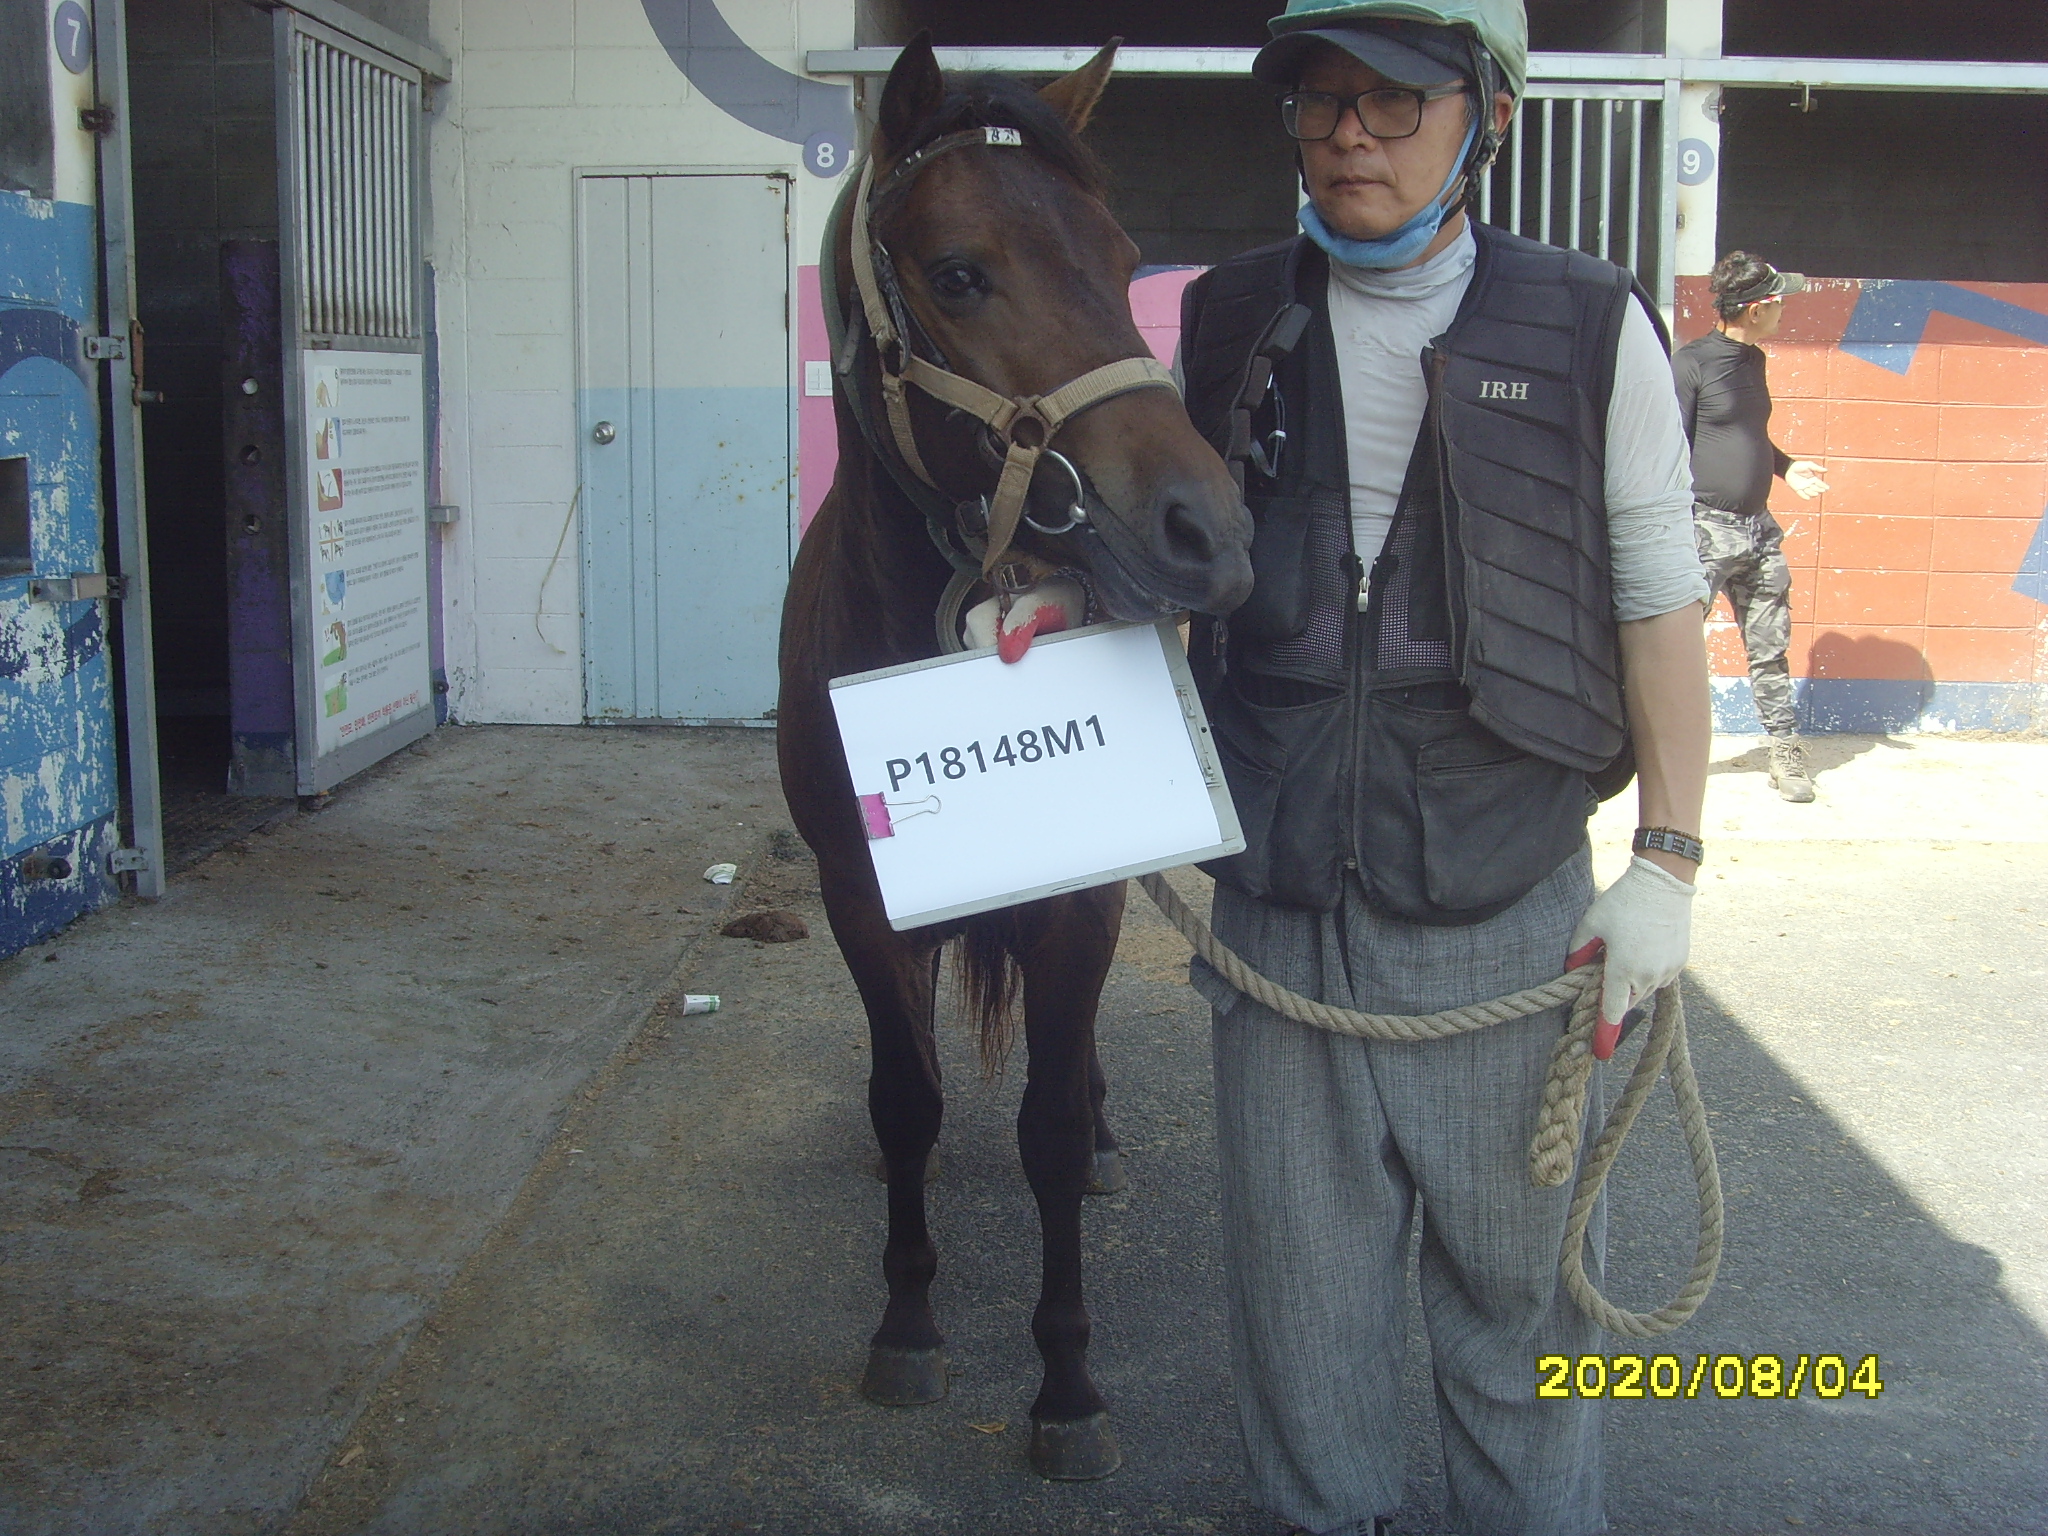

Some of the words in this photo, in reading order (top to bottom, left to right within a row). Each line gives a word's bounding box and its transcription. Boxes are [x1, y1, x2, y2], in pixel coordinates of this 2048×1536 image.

[67, 18, 81, 57] 7
[816, 142, 835, 168] 8
[1682, 149, 1701, 175] 9
[1479, 381, 1529, 400] IRH
[886, 714, 1106, 792] P18148M1
